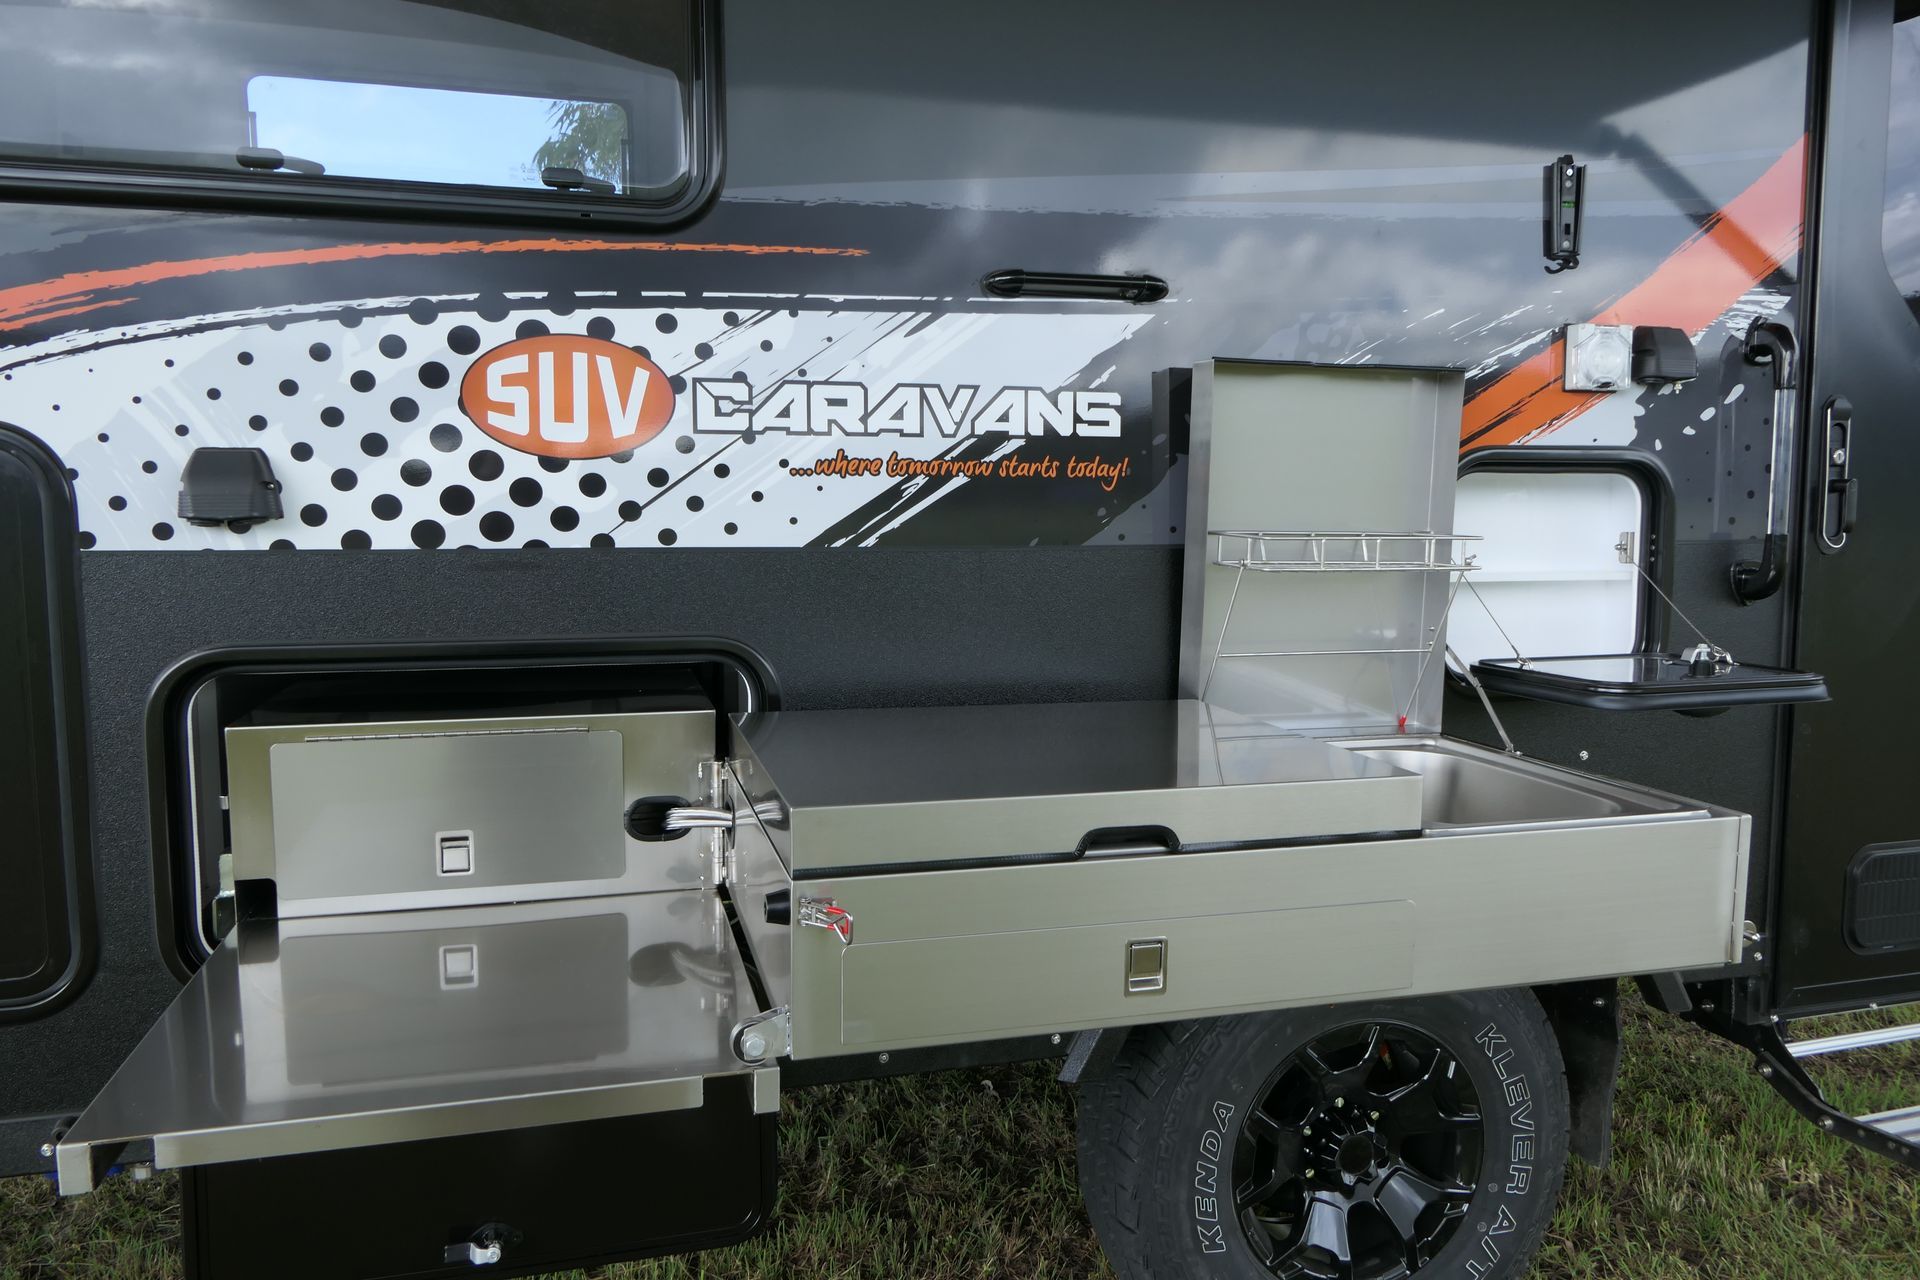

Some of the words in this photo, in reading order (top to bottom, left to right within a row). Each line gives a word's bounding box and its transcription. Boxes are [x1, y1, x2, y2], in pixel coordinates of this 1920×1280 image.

[486, 351, 650, 443] SUV
[692, 377, 1122, 438] CARAVANS
[886, 450, 994, 478] tomorrow
[999, 453, 1060, 478] starts
[1066, 454, 1130, 492] today!
[1475, 1022, 1535, 1195] KLEVER
[1194, 1100, 1235, 1253] KENDA
